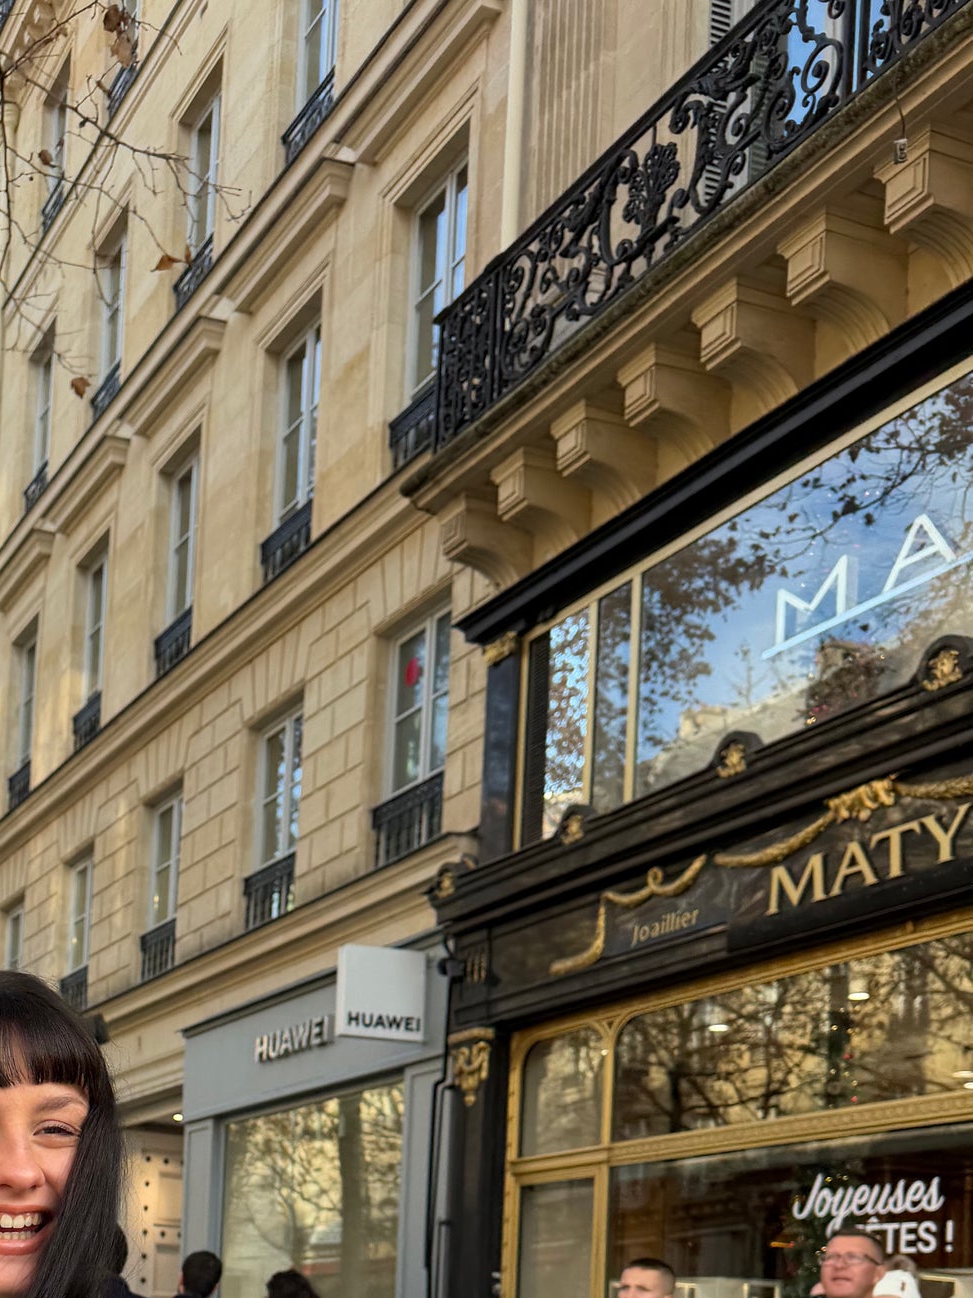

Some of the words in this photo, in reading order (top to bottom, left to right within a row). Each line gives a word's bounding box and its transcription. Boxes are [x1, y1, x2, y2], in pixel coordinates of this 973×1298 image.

[765, 802, 973, 916] MATY
[630, 906, 700, 948] Joaillier
[254, 1015, 332, 1064] HUAWEI
[347, 1011, 421, 1032] HUAWEI
[792, 1173, 944, 1238] Joyeuses
